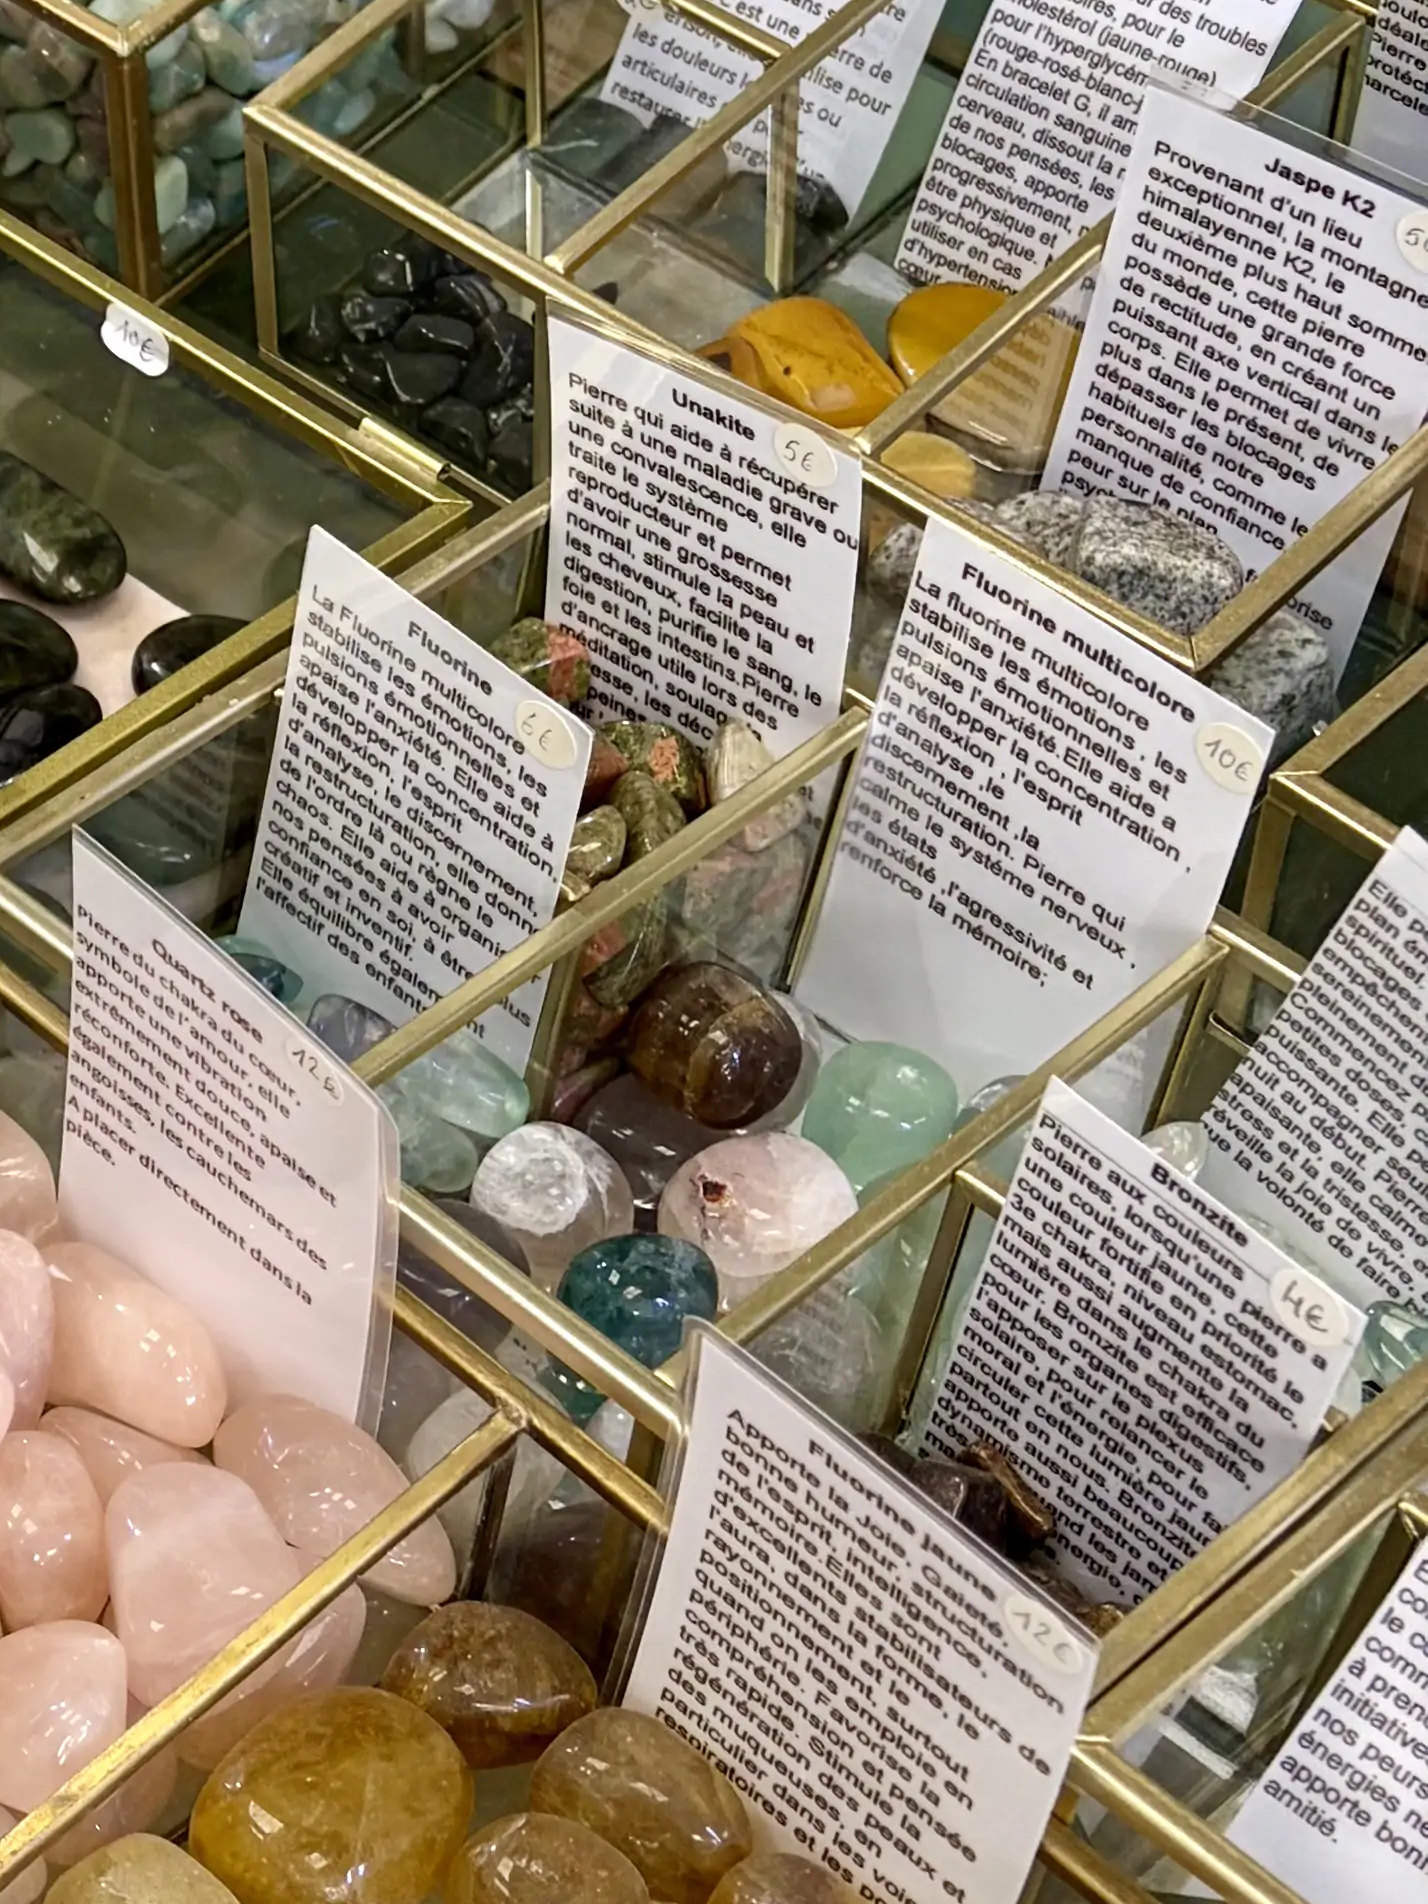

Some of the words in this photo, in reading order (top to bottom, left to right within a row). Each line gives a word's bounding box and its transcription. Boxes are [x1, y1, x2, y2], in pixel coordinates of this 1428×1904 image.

[1154, 140, 1265, 204] Provenant
[1269, 196, 1316, 228] d'un
[1322, 216, 1363, 249] lieu
[1264, 158, 1336, 200] Jaspe
[1341, 189, 1376, 219] K2
[1131, 233, 1158, 255] du
[1162, 248, 1238, 298] monde,
[1246, 290, 1298, 324] cette
[1301, 318, 1365, 358] pierre
[568, 372, 628, 412] Pierre
[633, 406, 664, 430] qui
[670, 423, 714, 453] aide
[719, 443, 732, 464] à
[738, 455, 839, 515] récupérer
[672, 387, 756, 441] Unakite
[784, 439, 814, 472] 5€
[568, 440, 617, 476] traite
[622, 466, 639, 488] le
[645, 482, 728, 533] système
[407, 620, 493, 696] Fluorine
[915, 570, 942, 601] La
[946, 591, 1026, 652] fluorine
[1031, 647, 1150, 731] multicolore
[961, 562, 1057, 634] Fluorine
[1062, 629, 1195, 723] multicolore
[307, 611, 383, 674] stabilise
[387, 666, 416, 698] les
[420, 693, 512, 775] émotions,
[518, 764, 548, 798] les
[521, 712, 553, 752] 6€
[900, 620, 988, 683] pulsions
[993, 676, 1142, 782] émotionnelles
[1148, 779, 1170, 802] et
[1204, 738, 1253, 782] 10€
[151, 938, 216, 1003] Quartz
[222, 1000, 263, 1044] rose
[1332, 927, 1423, 1012] blocages
[1274, 1008, 1342, 1068] petites
[1344, 1068, 1406, 1129] doses,
[66, 1118, 116, 1166] pièce.
[1039, 1113, 1103, 1171] Pierre
[1106, 1169, 1147, 1206] aux
[1152, 1204, 1244, 1282] couleurs
[1150, 1162, 1248, 1248] Bronzite
[1031, 1136, 1117, 1212] solaires,
[1124, 1204, 1236, 1300] lorsqu'une
[1239, 1299, 1306, 1354] pierre
[1311, 1353, 1328, 1372] a
[1281, 1280, 1329, 1334] 4€
[808, 1439, 916, 1536] Fluorine
[920, 1533, 997, 1602] jaune
[704, 1528, 854, 1660] rayonnement
[860, 1659, 883, 1685] et
[888, 1679, 911, 1706] le
[1263, 1779, 1337, 1843] amitié.
[1279, 1755, 1372, 1827] apporte
[1297, 1729, 1401, 1813] énergies
